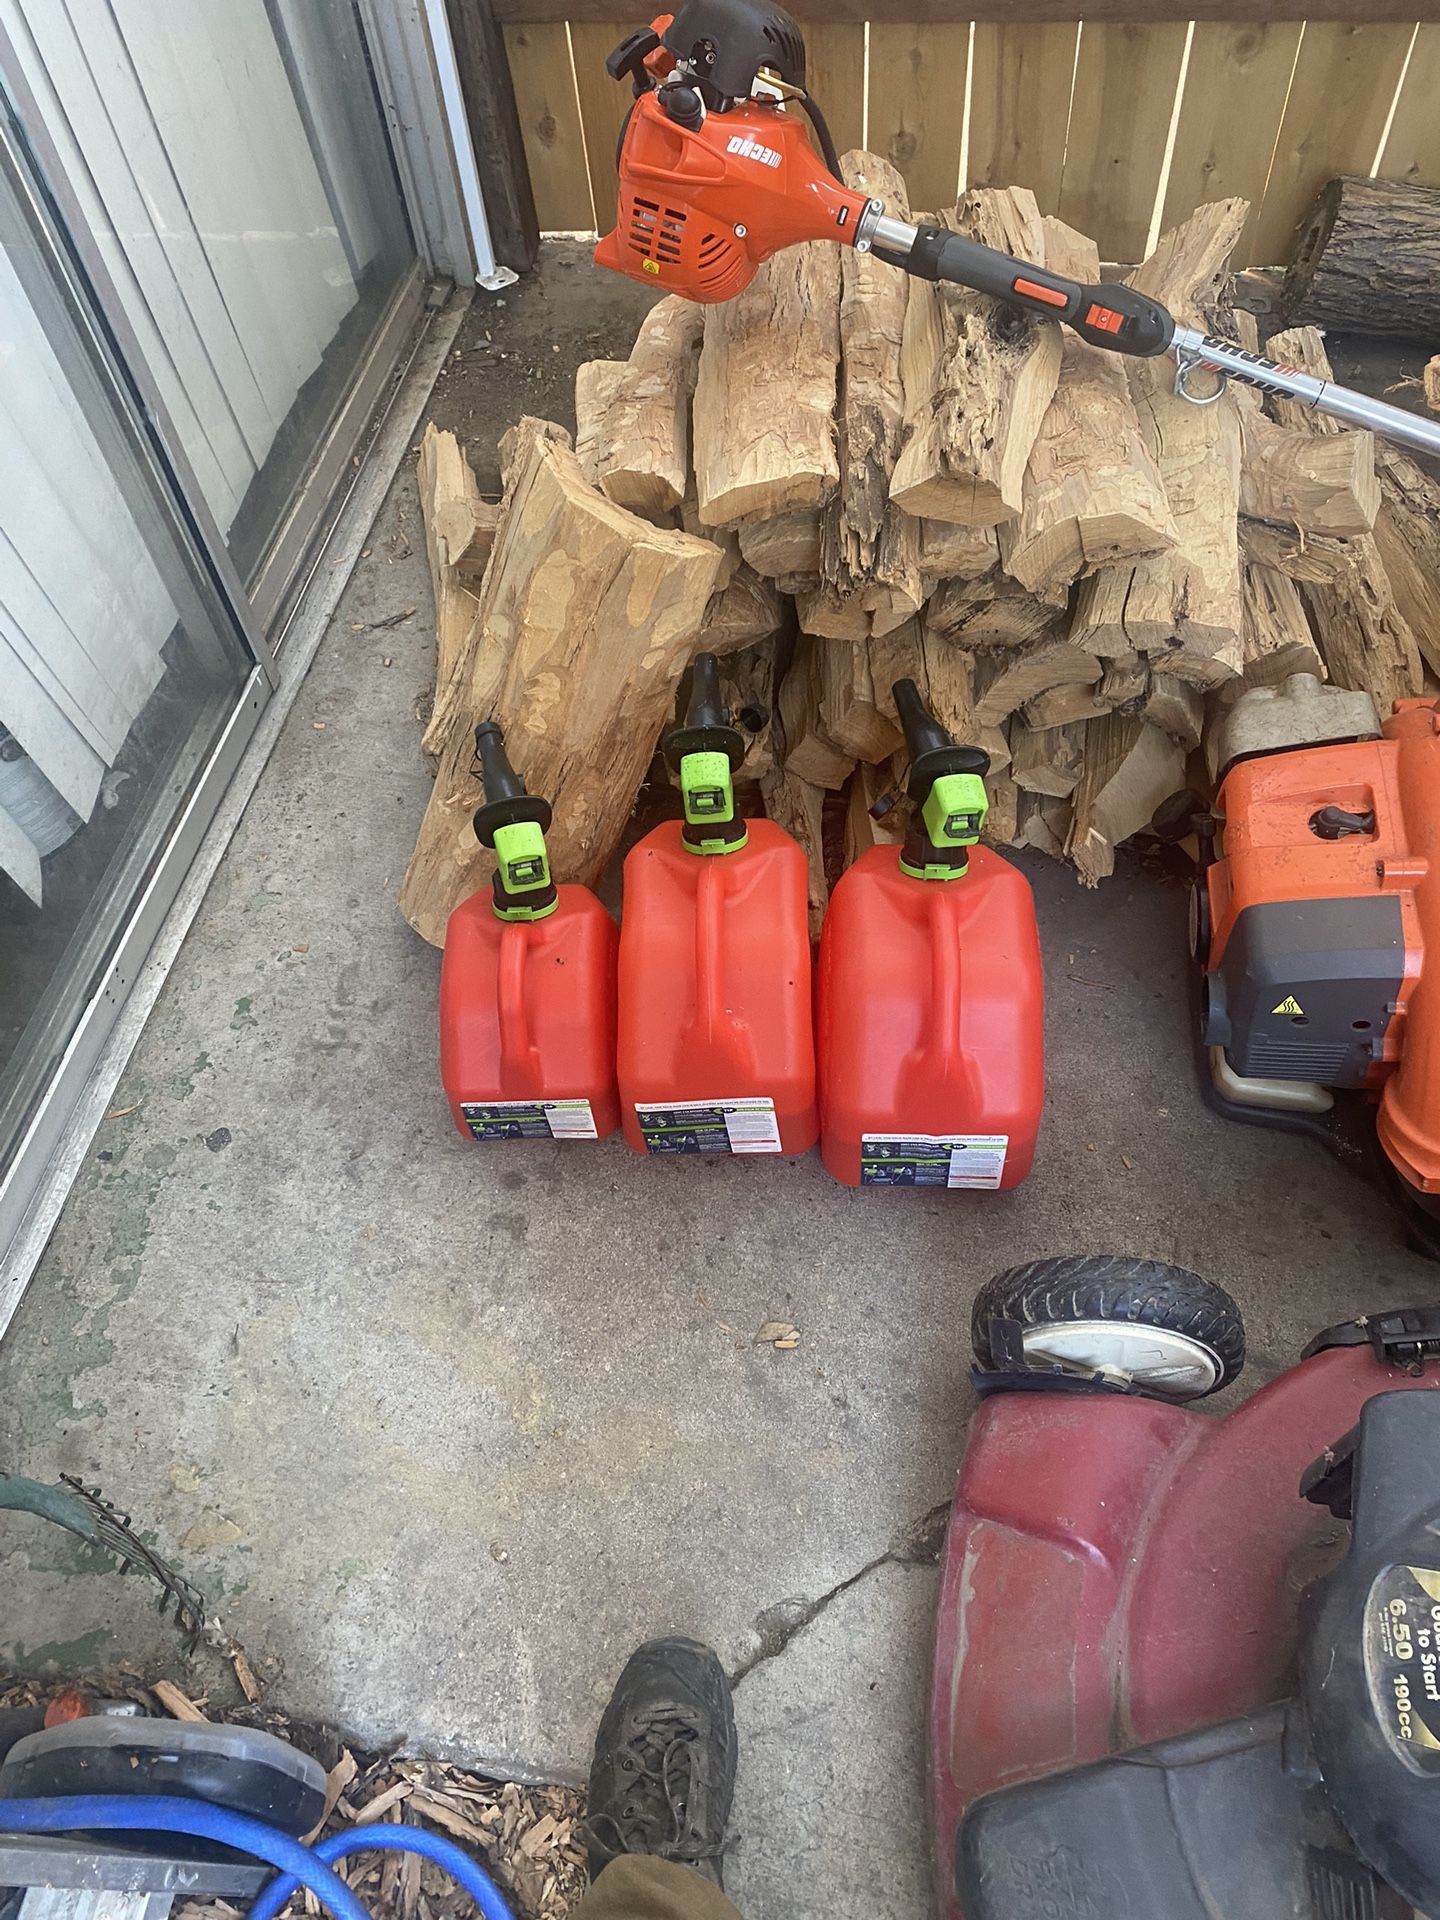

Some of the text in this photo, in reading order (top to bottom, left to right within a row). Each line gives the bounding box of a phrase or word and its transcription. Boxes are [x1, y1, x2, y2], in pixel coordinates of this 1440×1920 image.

[726, 137, 776, 166] ECHO
[1389, 1598, 1414, 1660] 6.50
[1417, 1628, 1431, 1648] to
[1421, 1653, 1440, 1701] Start
[1393, 1673, 1412, 1739] 190cc
